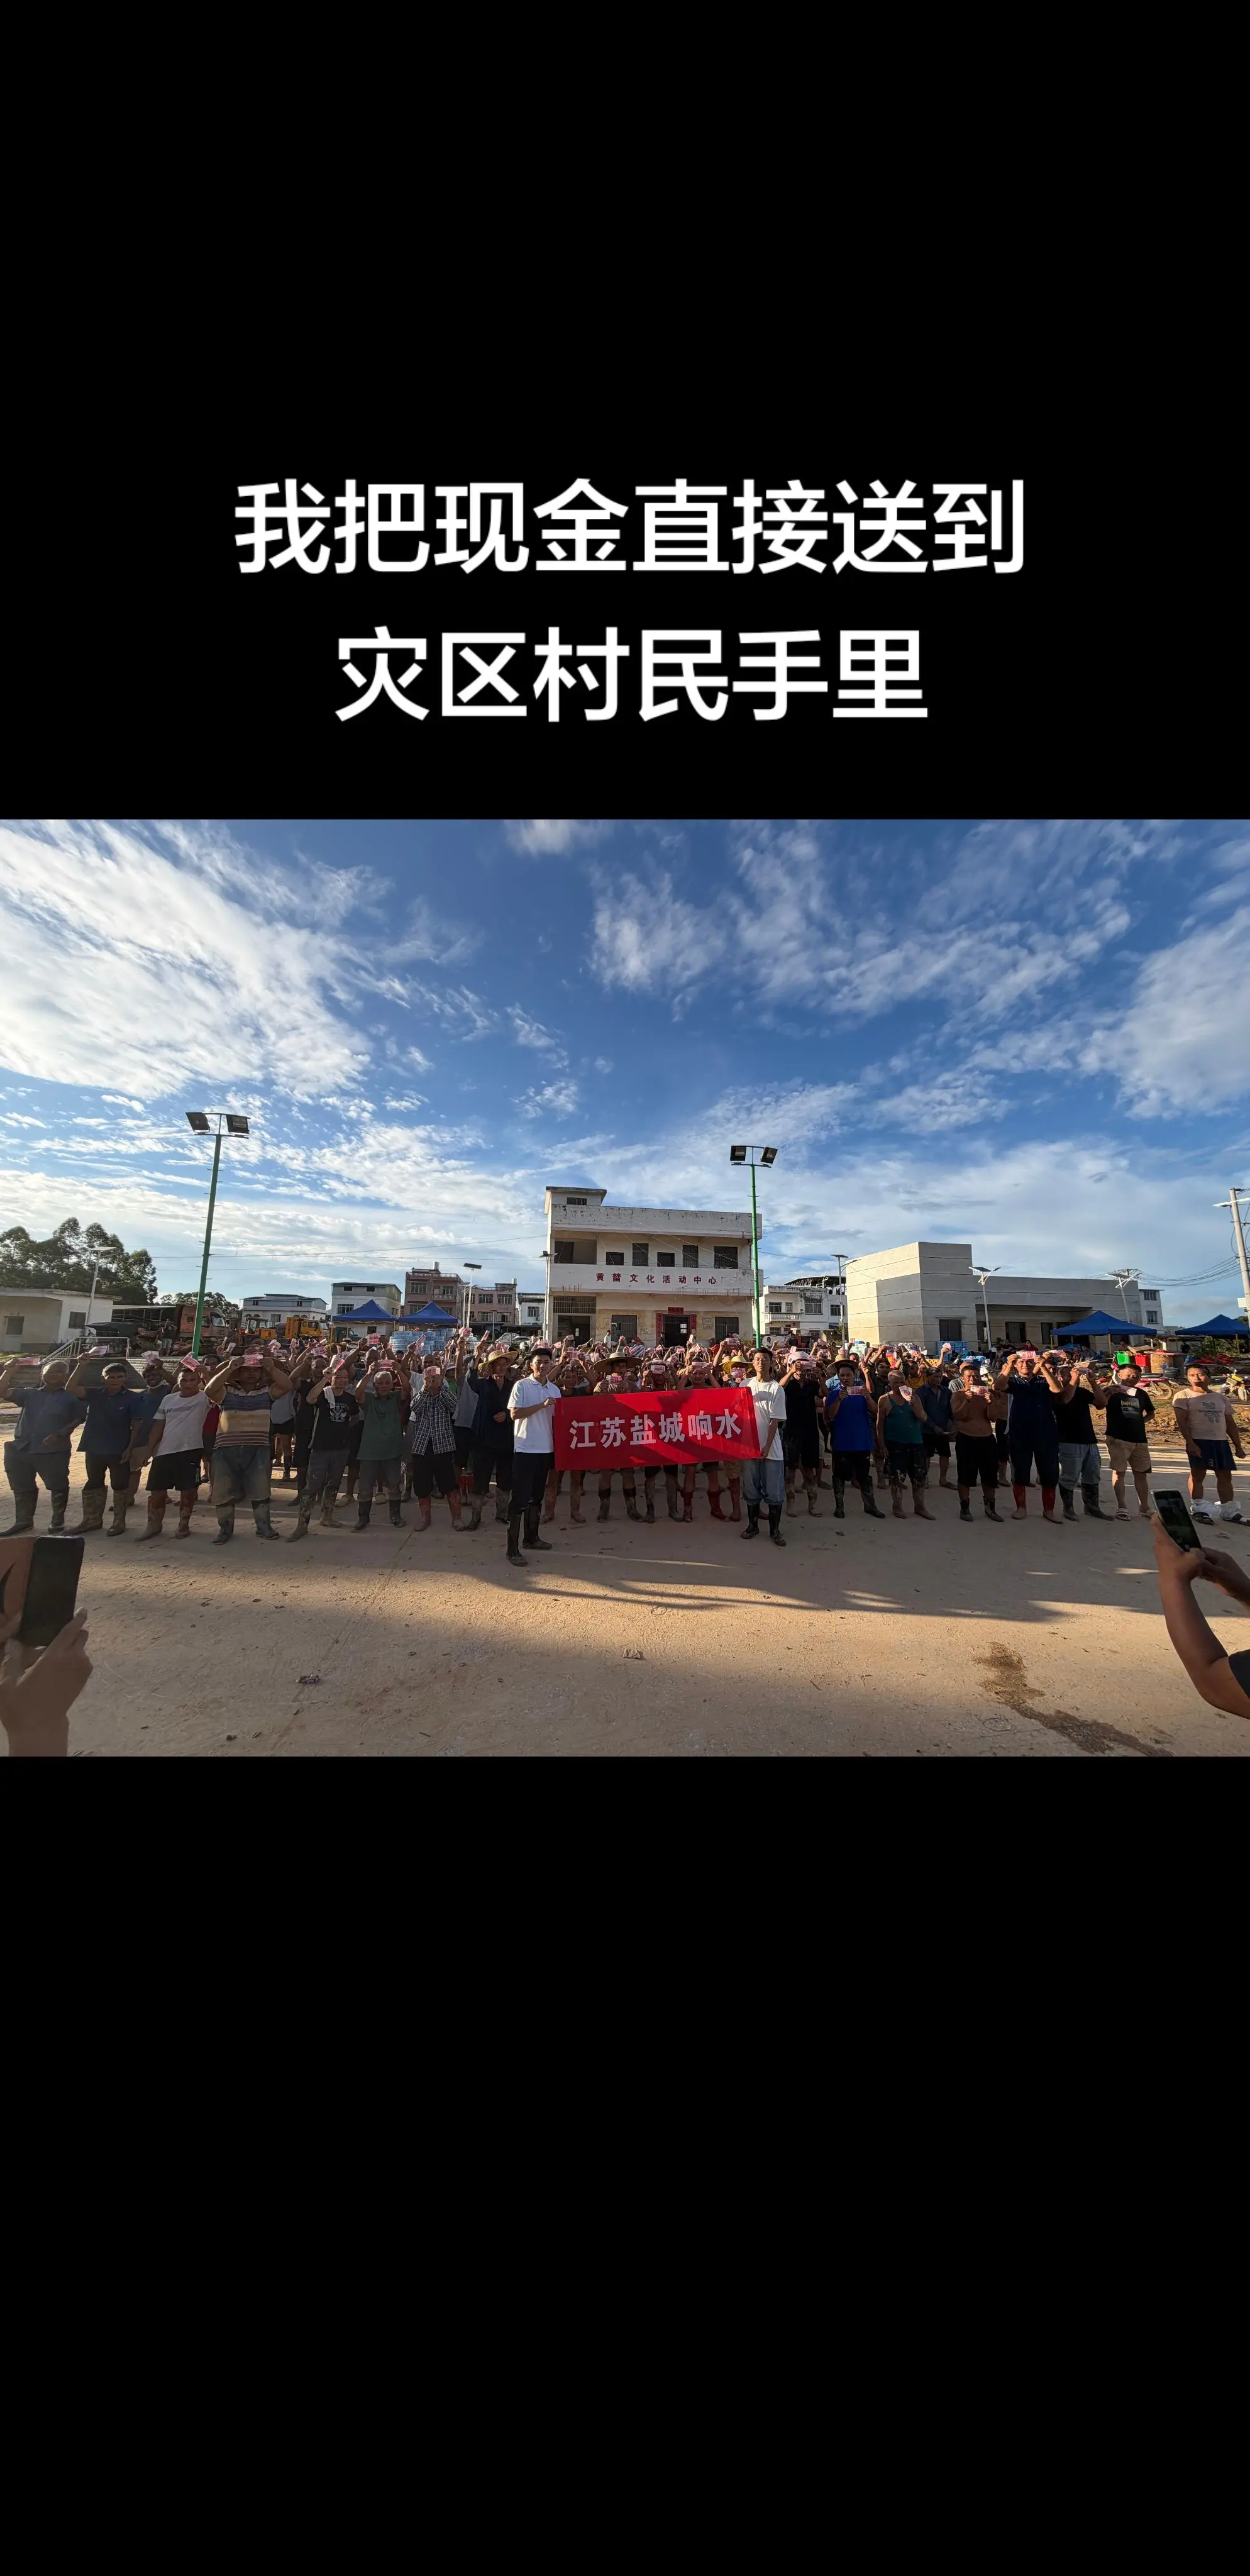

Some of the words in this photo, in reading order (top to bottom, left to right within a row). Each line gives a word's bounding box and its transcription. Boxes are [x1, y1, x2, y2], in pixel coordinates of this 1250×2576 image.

[568, 1408, 741, 1450] 江苏盐城响水
